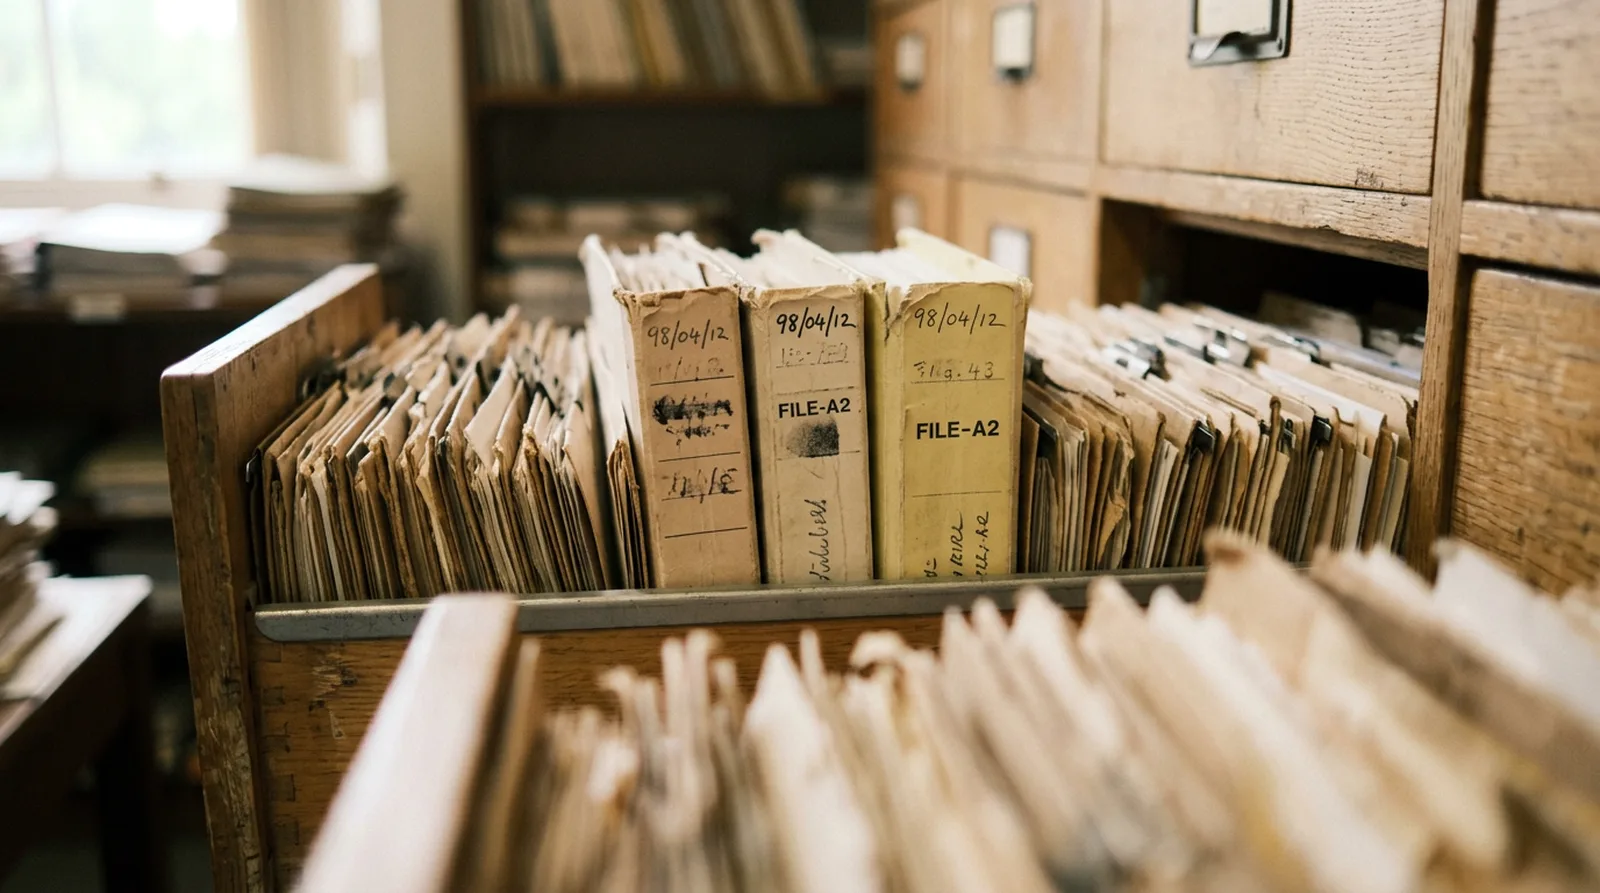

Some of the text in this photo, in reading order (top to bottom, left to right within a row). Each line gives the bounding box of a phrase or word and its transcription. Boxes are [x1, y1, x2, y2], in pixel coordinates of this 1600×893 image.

[776, 305, 857, 338] 98/04/12
[914, 302, 1006, 335] 98/04/12
[647, 319, 729, 350] 98/04/12
[778, 397, 851, 418] FILE-A2
[916, 420, 1000, 440] FILE-A2
